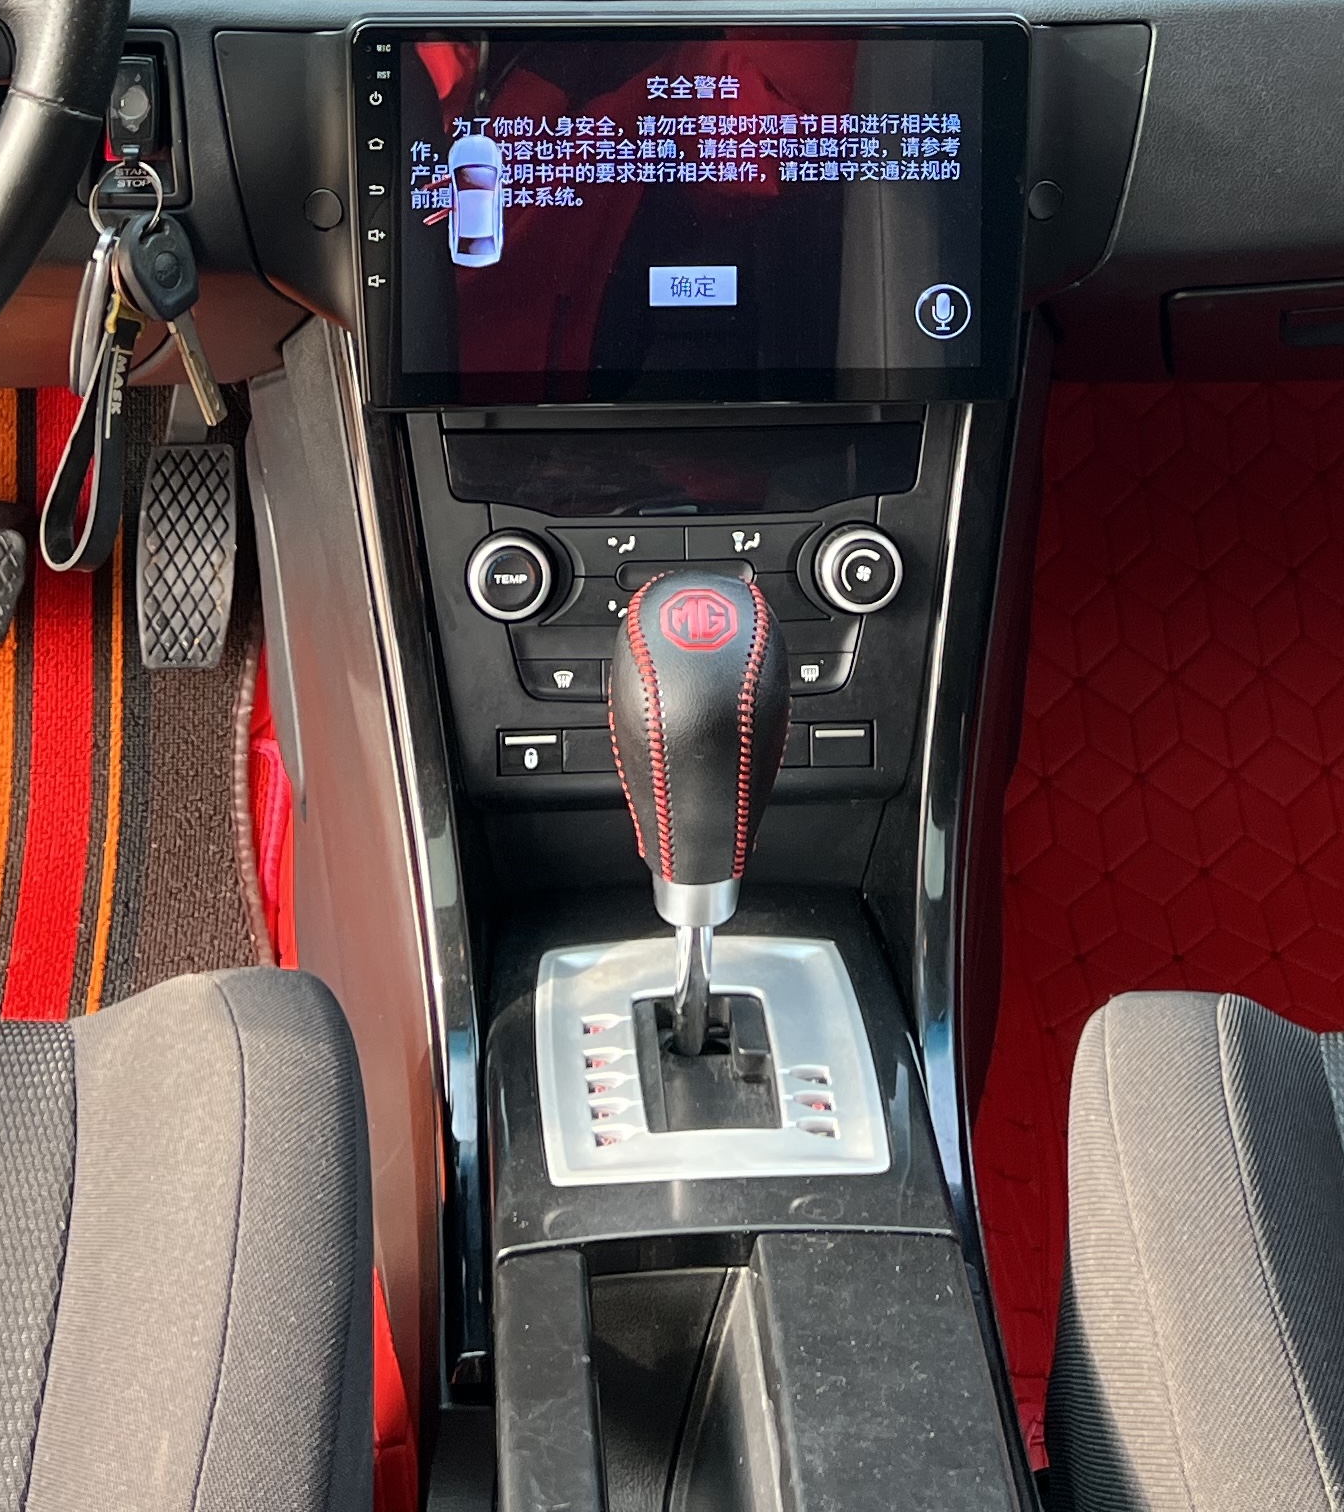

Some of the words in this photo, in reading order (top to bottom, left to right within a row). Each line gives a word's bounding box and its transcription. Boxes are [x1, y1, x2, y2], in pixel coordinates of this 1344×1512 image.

[646, 75, 741, 100] 安全警告
[670, 275, 717, 298] 确定
[111, 354, 129, 416] MASK
[493, 573, 529, 585] TEMP
[671, 597, 727, 642] MG
